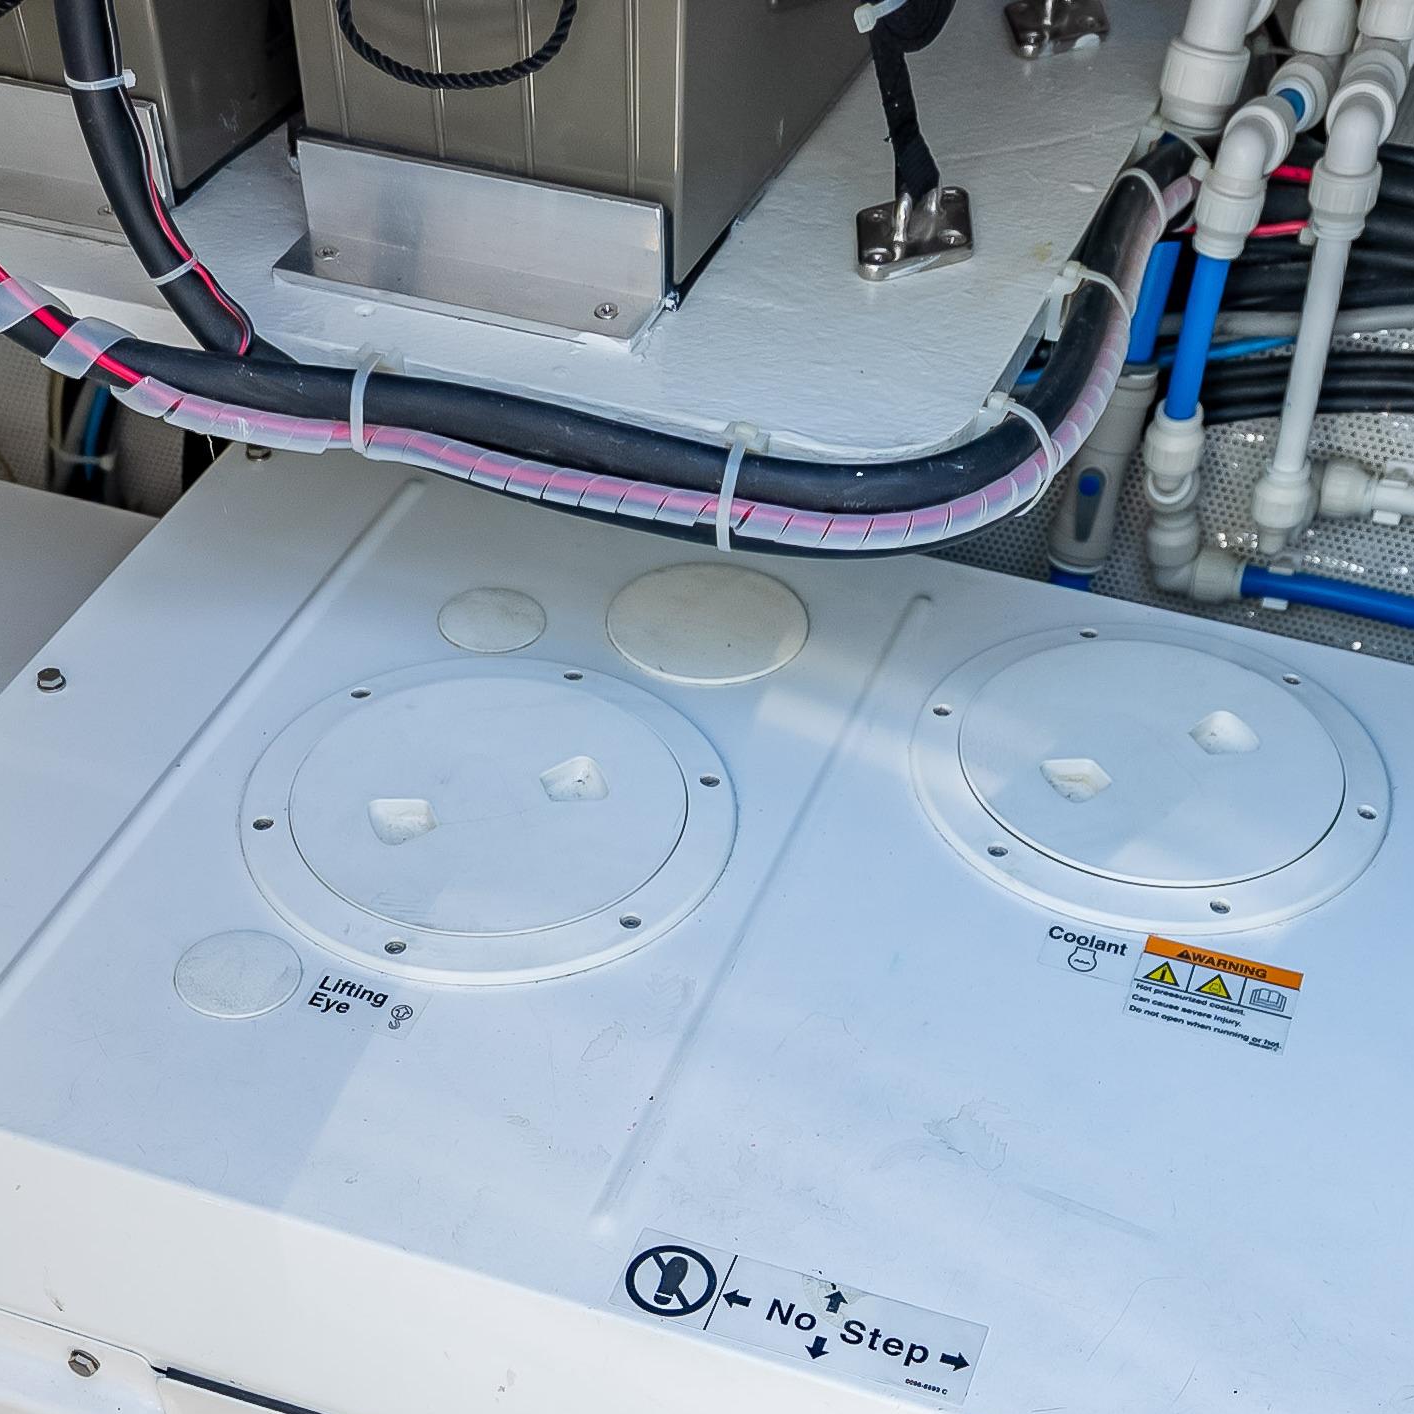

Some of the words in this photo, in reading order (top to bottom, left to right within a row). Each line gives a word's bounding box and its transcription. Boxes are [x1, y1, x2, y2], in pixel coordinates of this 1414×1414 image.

[1049, 925, 1128, 956] Coolant
[1191, 951, 1268, 979] WARNING
[308, 991, 350, 1013] Eye
[319, 976, 388, 1008] Lifting
[1136, 983, 1152, 993] Hot
[1154, 987, 1207, 1006] pressurized
[1129, 1005, 1142, 1013] Do
[1144, 1009, 1160, 1018] not
[1161, 1013, 1184, 1025] open
[1186, 1019, 1212, 1032] when
[1213, 1027, 1250, 1042] running
[1251, 1036, 1262, 1044] or
[1131, 994, 1150, 1004] Can
[1152, 999, 1180, 1011] cause
[1181, 1006, 1212, 1019] severe
[1214, 1014, 1242, 1027] injury.
[765, 1298, 817, 1331] No
[840, 1320, 929, 1367] Step
